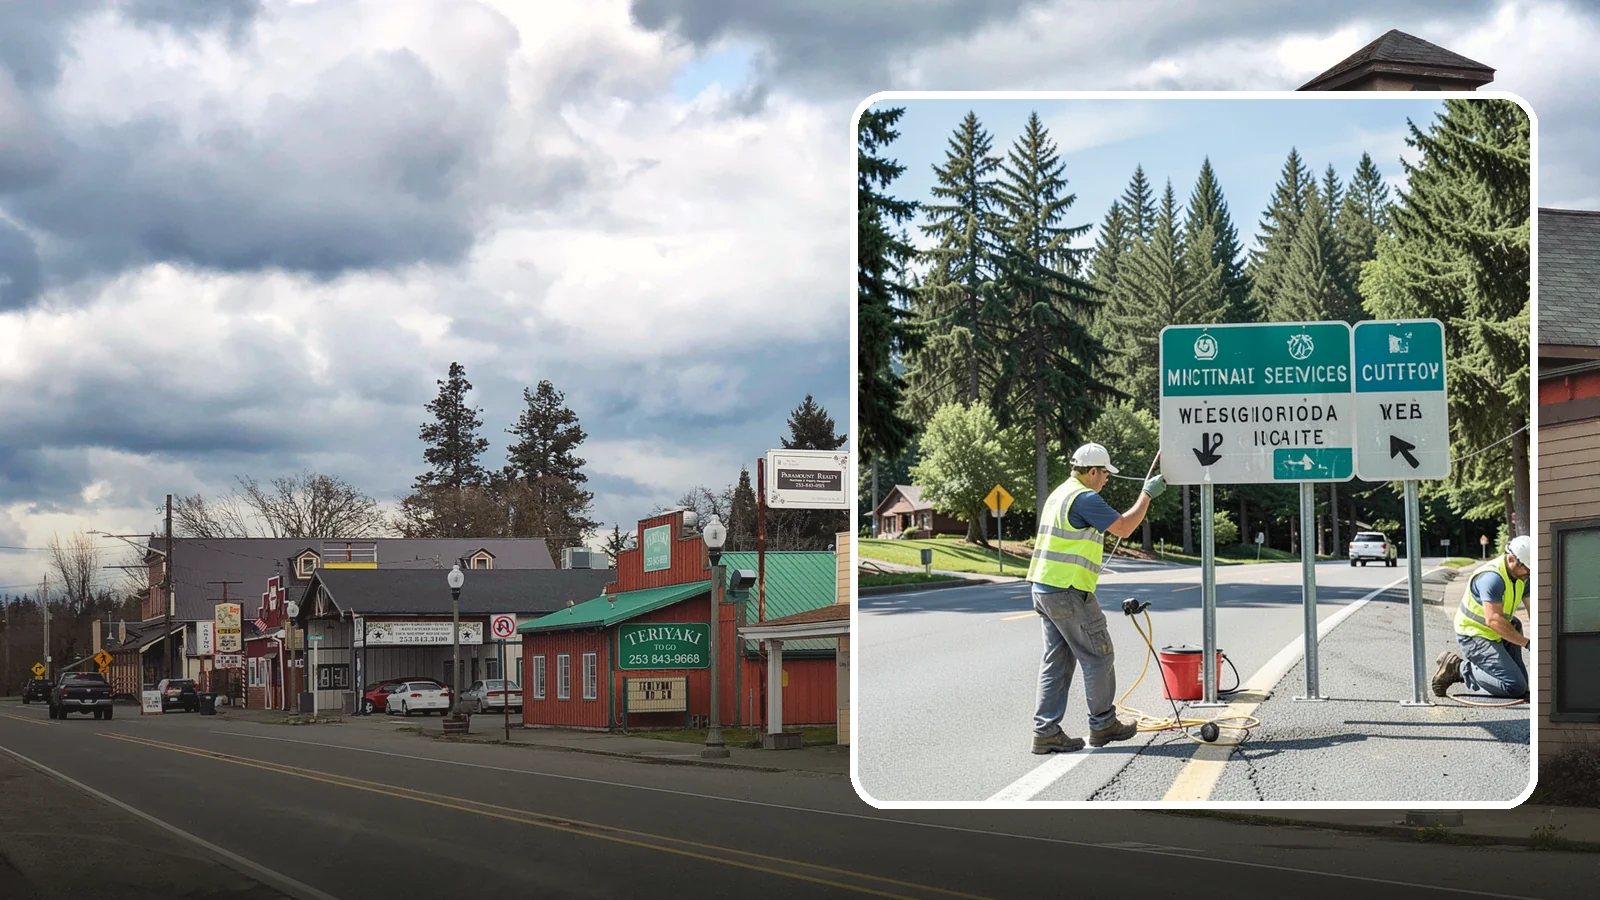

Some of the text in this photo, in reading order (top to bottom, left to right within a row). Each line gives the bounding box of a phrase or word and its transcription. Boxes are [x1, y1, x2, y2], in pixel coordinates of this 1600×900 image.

[817, 472, 839, 480] REALTY
[624, 627, 702, 646] TERIYAKI
[654, 643, 676, 651] TO GO
[629, 653, 700, 665] 253 843-9668
